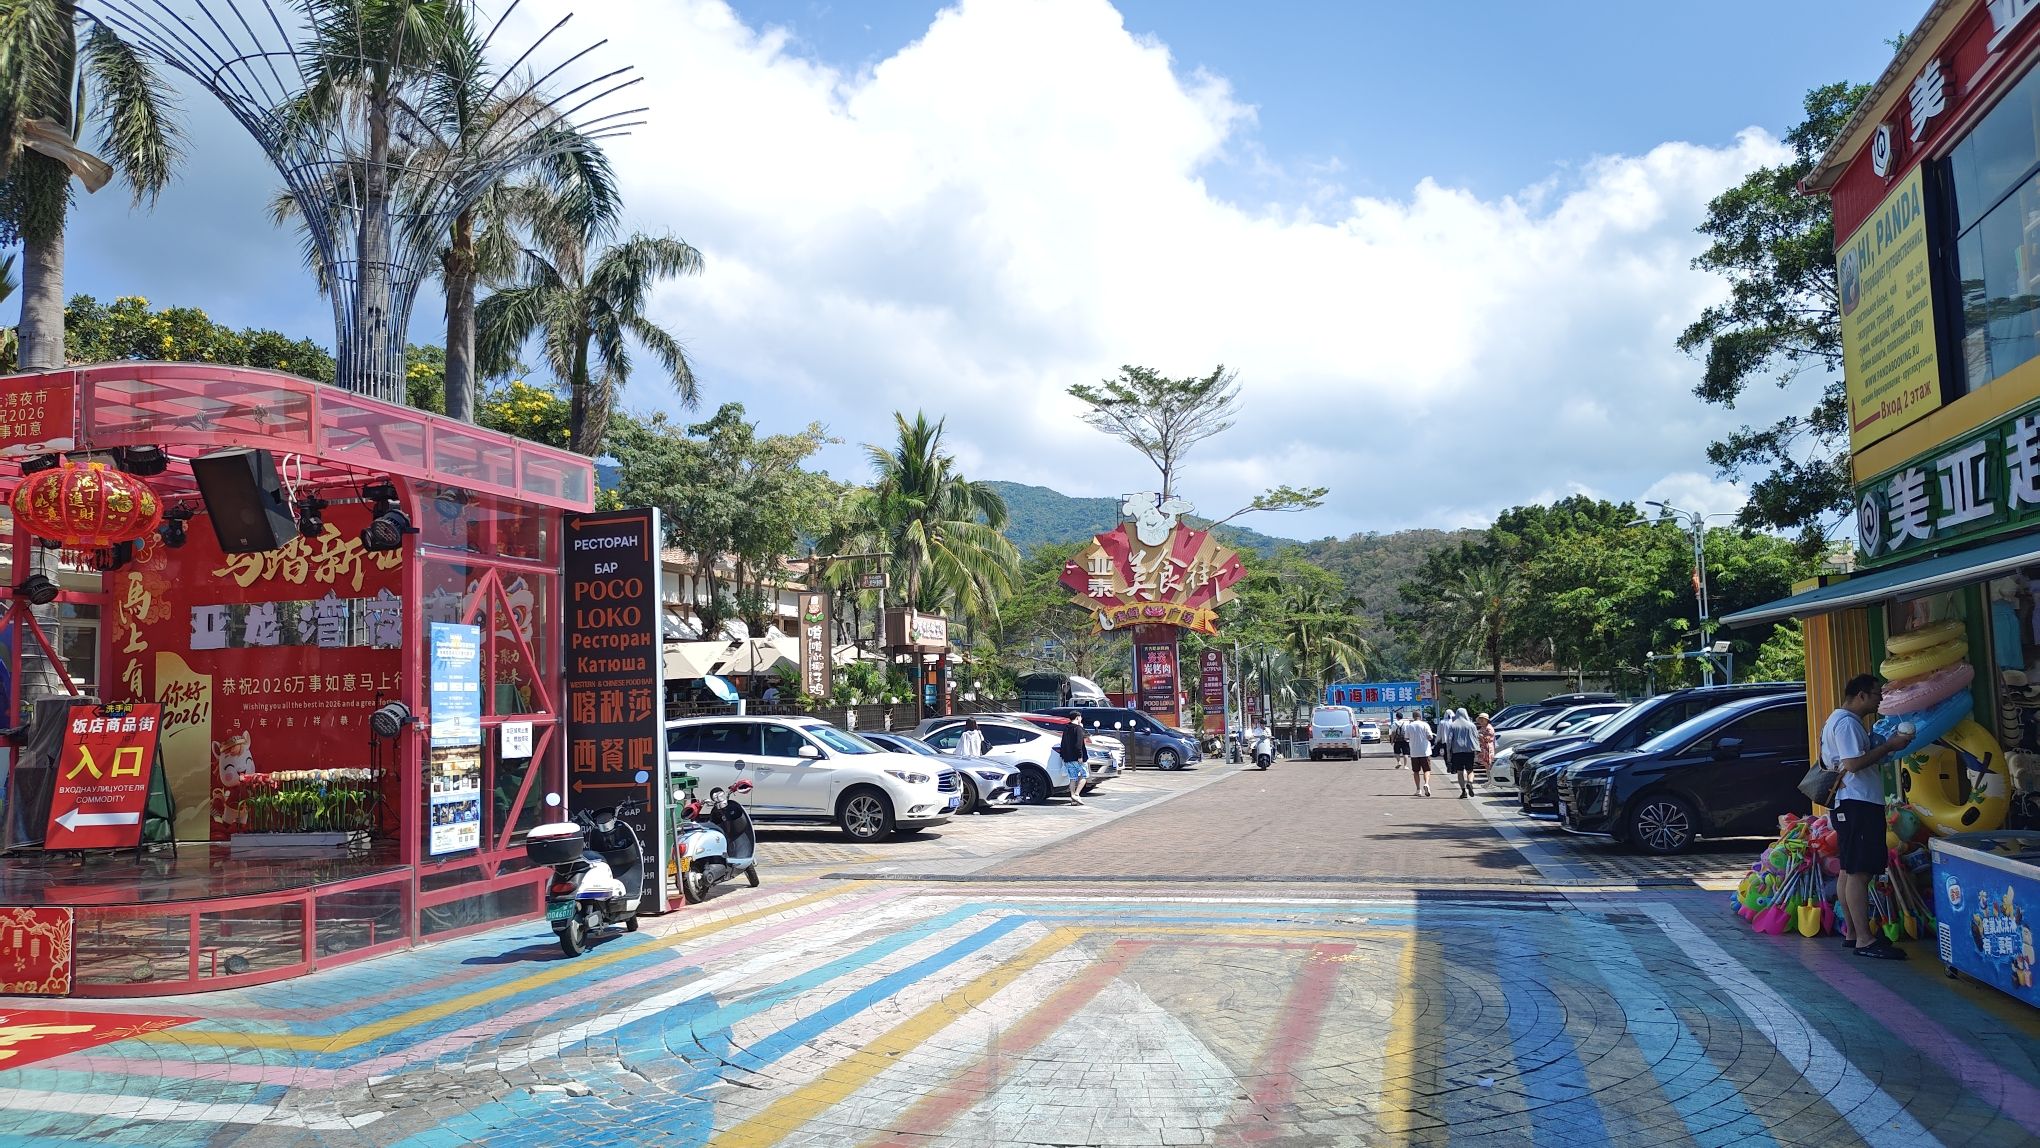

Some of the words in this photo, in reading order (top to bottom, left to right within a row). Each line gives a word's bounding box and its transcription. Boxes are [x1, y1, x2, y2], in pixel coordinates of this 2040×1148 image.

[1857, 227, 1874, 278] HI,
[1875, 177, 1920, 255] PANDA
[1880, 390, 1902, 424] Вход
[1903, 389, 1908, 409] 2
[1910, 379, 1931, 406] этаж
[574, 535, 638, 551] РЕСТОРАН
[594, 562, 618, 574] БАР
[1088, 547, 1113, 597] 亚泰
[1116, 550, 1227, 602] 美食街
[575, 578, 643, 601] POCO
[577, 606, 641, 629] LOKO
[573, 632, 651, 651] Ресторан
[578, 657, 646, 673] Катюша
[160, 681, 207, 707] 你好
[603, 679, 626, 687] CHINESE
[105, 704, 133, 714] 洗手间
[163, 702, 209, 730] 2026!
[573, 688, 652, 724] 喀秋莎
[72, 717, 154, 734] 饭店商品街
[66, 744, 144, 780] 入口
[574, 737, 653, 773] 西餐吧
[76, 795, 125, 804] COMMODITY
[636, 824, 646, 832] DJ
